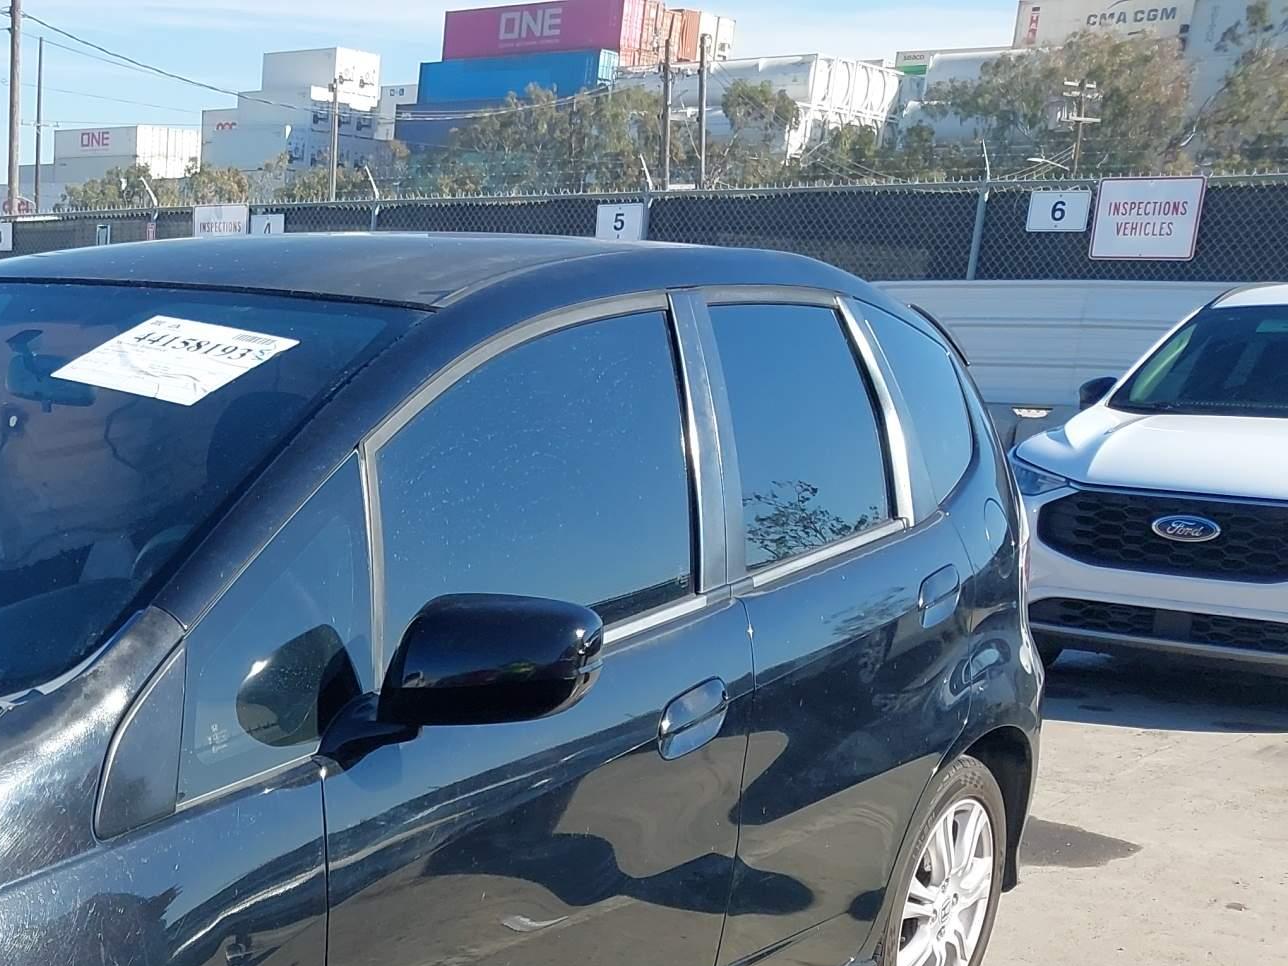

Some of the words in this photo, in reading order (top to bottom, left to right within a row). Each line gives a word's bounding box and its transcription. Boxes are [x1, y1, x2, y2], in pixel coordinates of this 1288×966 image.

[499, 8, 562, 40] ONE
[1086, 11, 1127, 26] CMA
[1133, 7, 1177, 22] CGM
[81, 131, 110, 147] ONE
[1050, 200, 1067, 222] 6
[1108, 200, 1188, 217] INSPECTIONS
[199, 221, 242, 233] INSPECTIONS
[613, 213, 625, 231] 5
[1116, 221, 1174, 237] VEHICLES
[133, 331, 254, 361] 44158193
[1166, 520, 1204, 537] Ford
